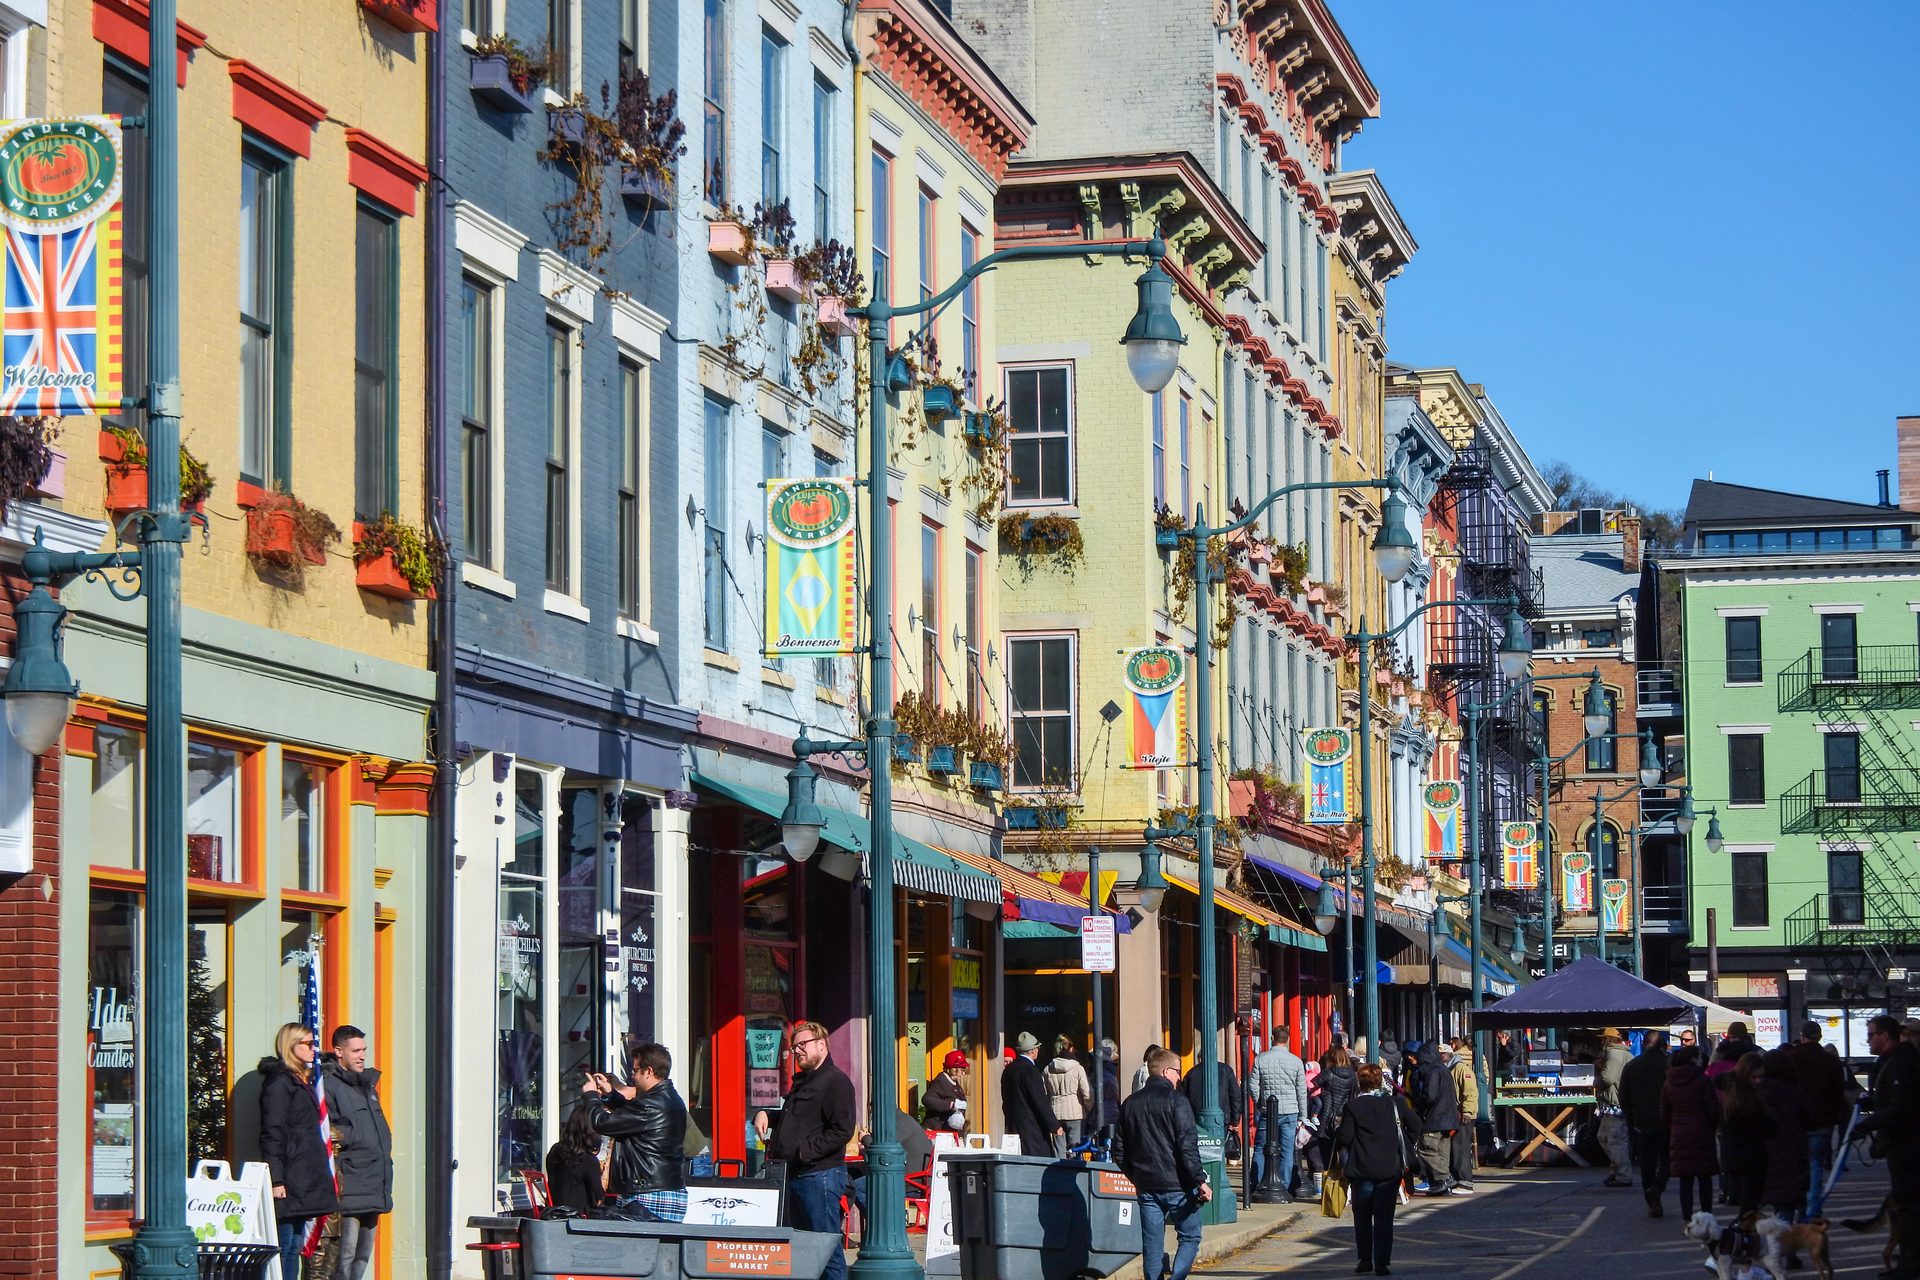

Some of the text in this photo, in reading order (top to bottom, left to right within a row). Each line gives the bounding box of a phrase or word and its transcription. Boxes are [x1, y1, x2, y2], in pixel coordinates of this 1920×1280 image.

[1, 123, 104, 160] FINDLAY
[10, 179, 105, 217] MARKET
[6, 366, 94, 386] Welcome
[778, 482, 842, 504] FINDLAY
[784, 516, 843, 539] MARKET
[776, 634, 841, 647] Bonvenon
[1131, 649, 1176, 664] FINDLAY
[1136, 673, 1177, 688] MARKET
[1083, 919, 1093, 931] NO
[88, 1041, 135, 1068] Candles
[969, 1177, 974, 1186] 9
[188, 1198, 247, 1214] Candles
[1122, 1208, 1128, 1217] 9
[711, 1211, 736, 1226] The
[716, 1243, 766, 1252] PROPERTY
[504, 1250, 510, 1264] 8
[729, 1253, 769, 1261] FINDLAY
[729, 1261, 769, 1270] MARKET
